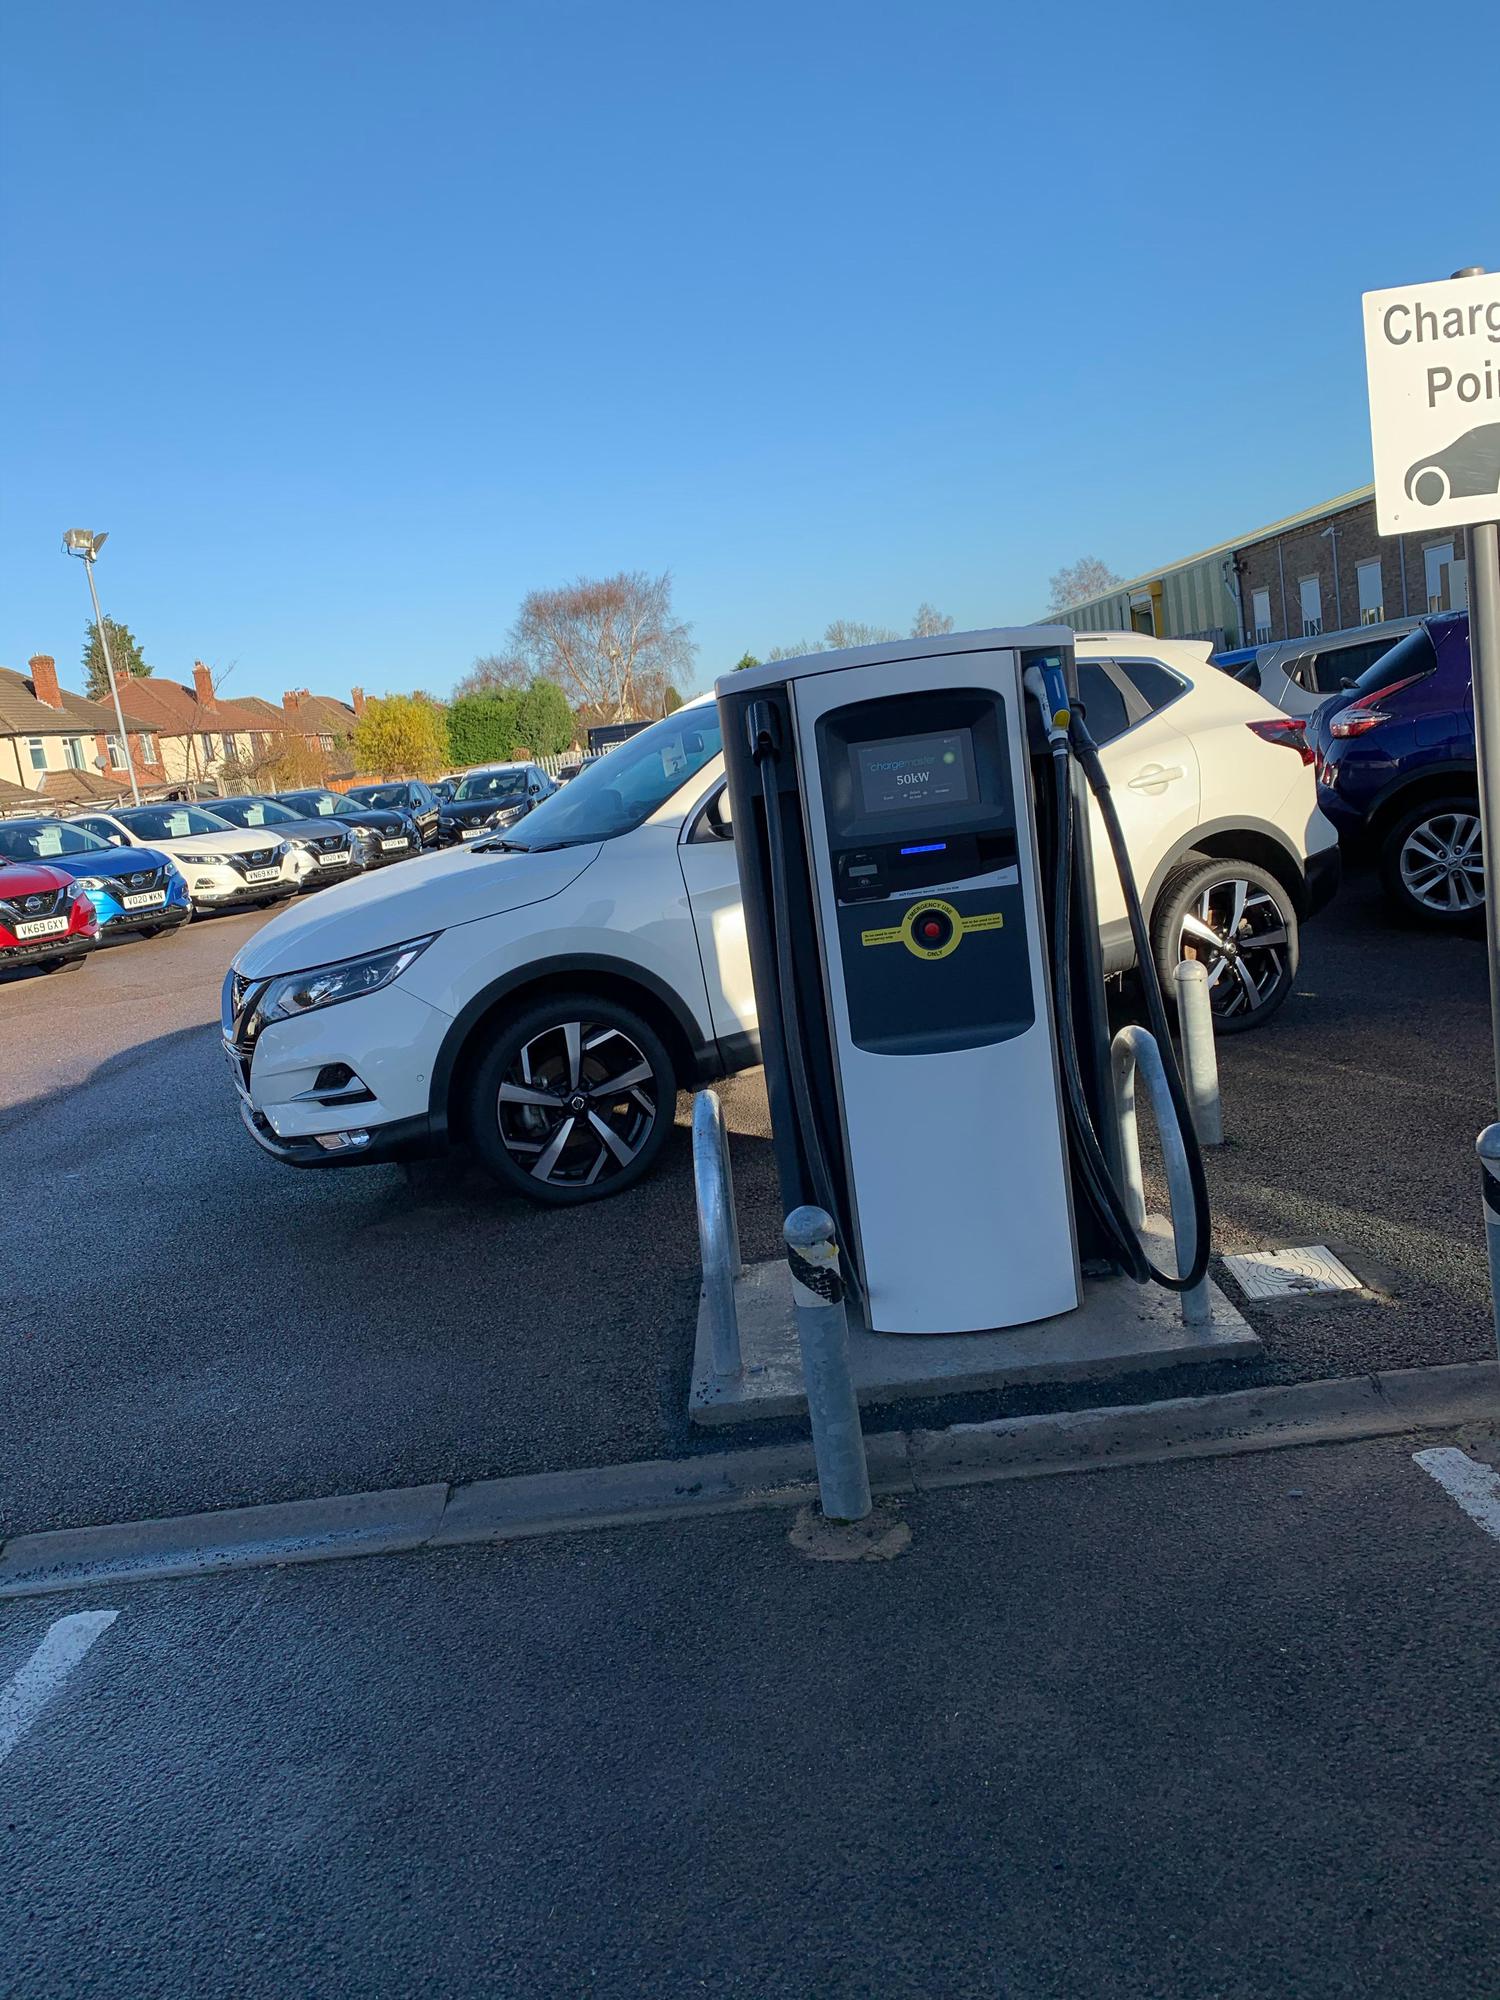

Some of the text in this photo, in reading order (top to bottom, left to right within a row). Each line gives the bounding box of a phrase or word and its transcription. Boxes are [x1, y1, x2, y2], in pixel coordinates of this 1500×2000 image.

[1427, 360, 1500, 407] Poi
[896, 771, 929, 785] 50kW
[249, 870, 266, 879] VN69
[148, 891, 163, 901] WKN
[907, 902, 953, 921] EMERGENCY USE
[21, 918, 64, 935] VK69 GXY
